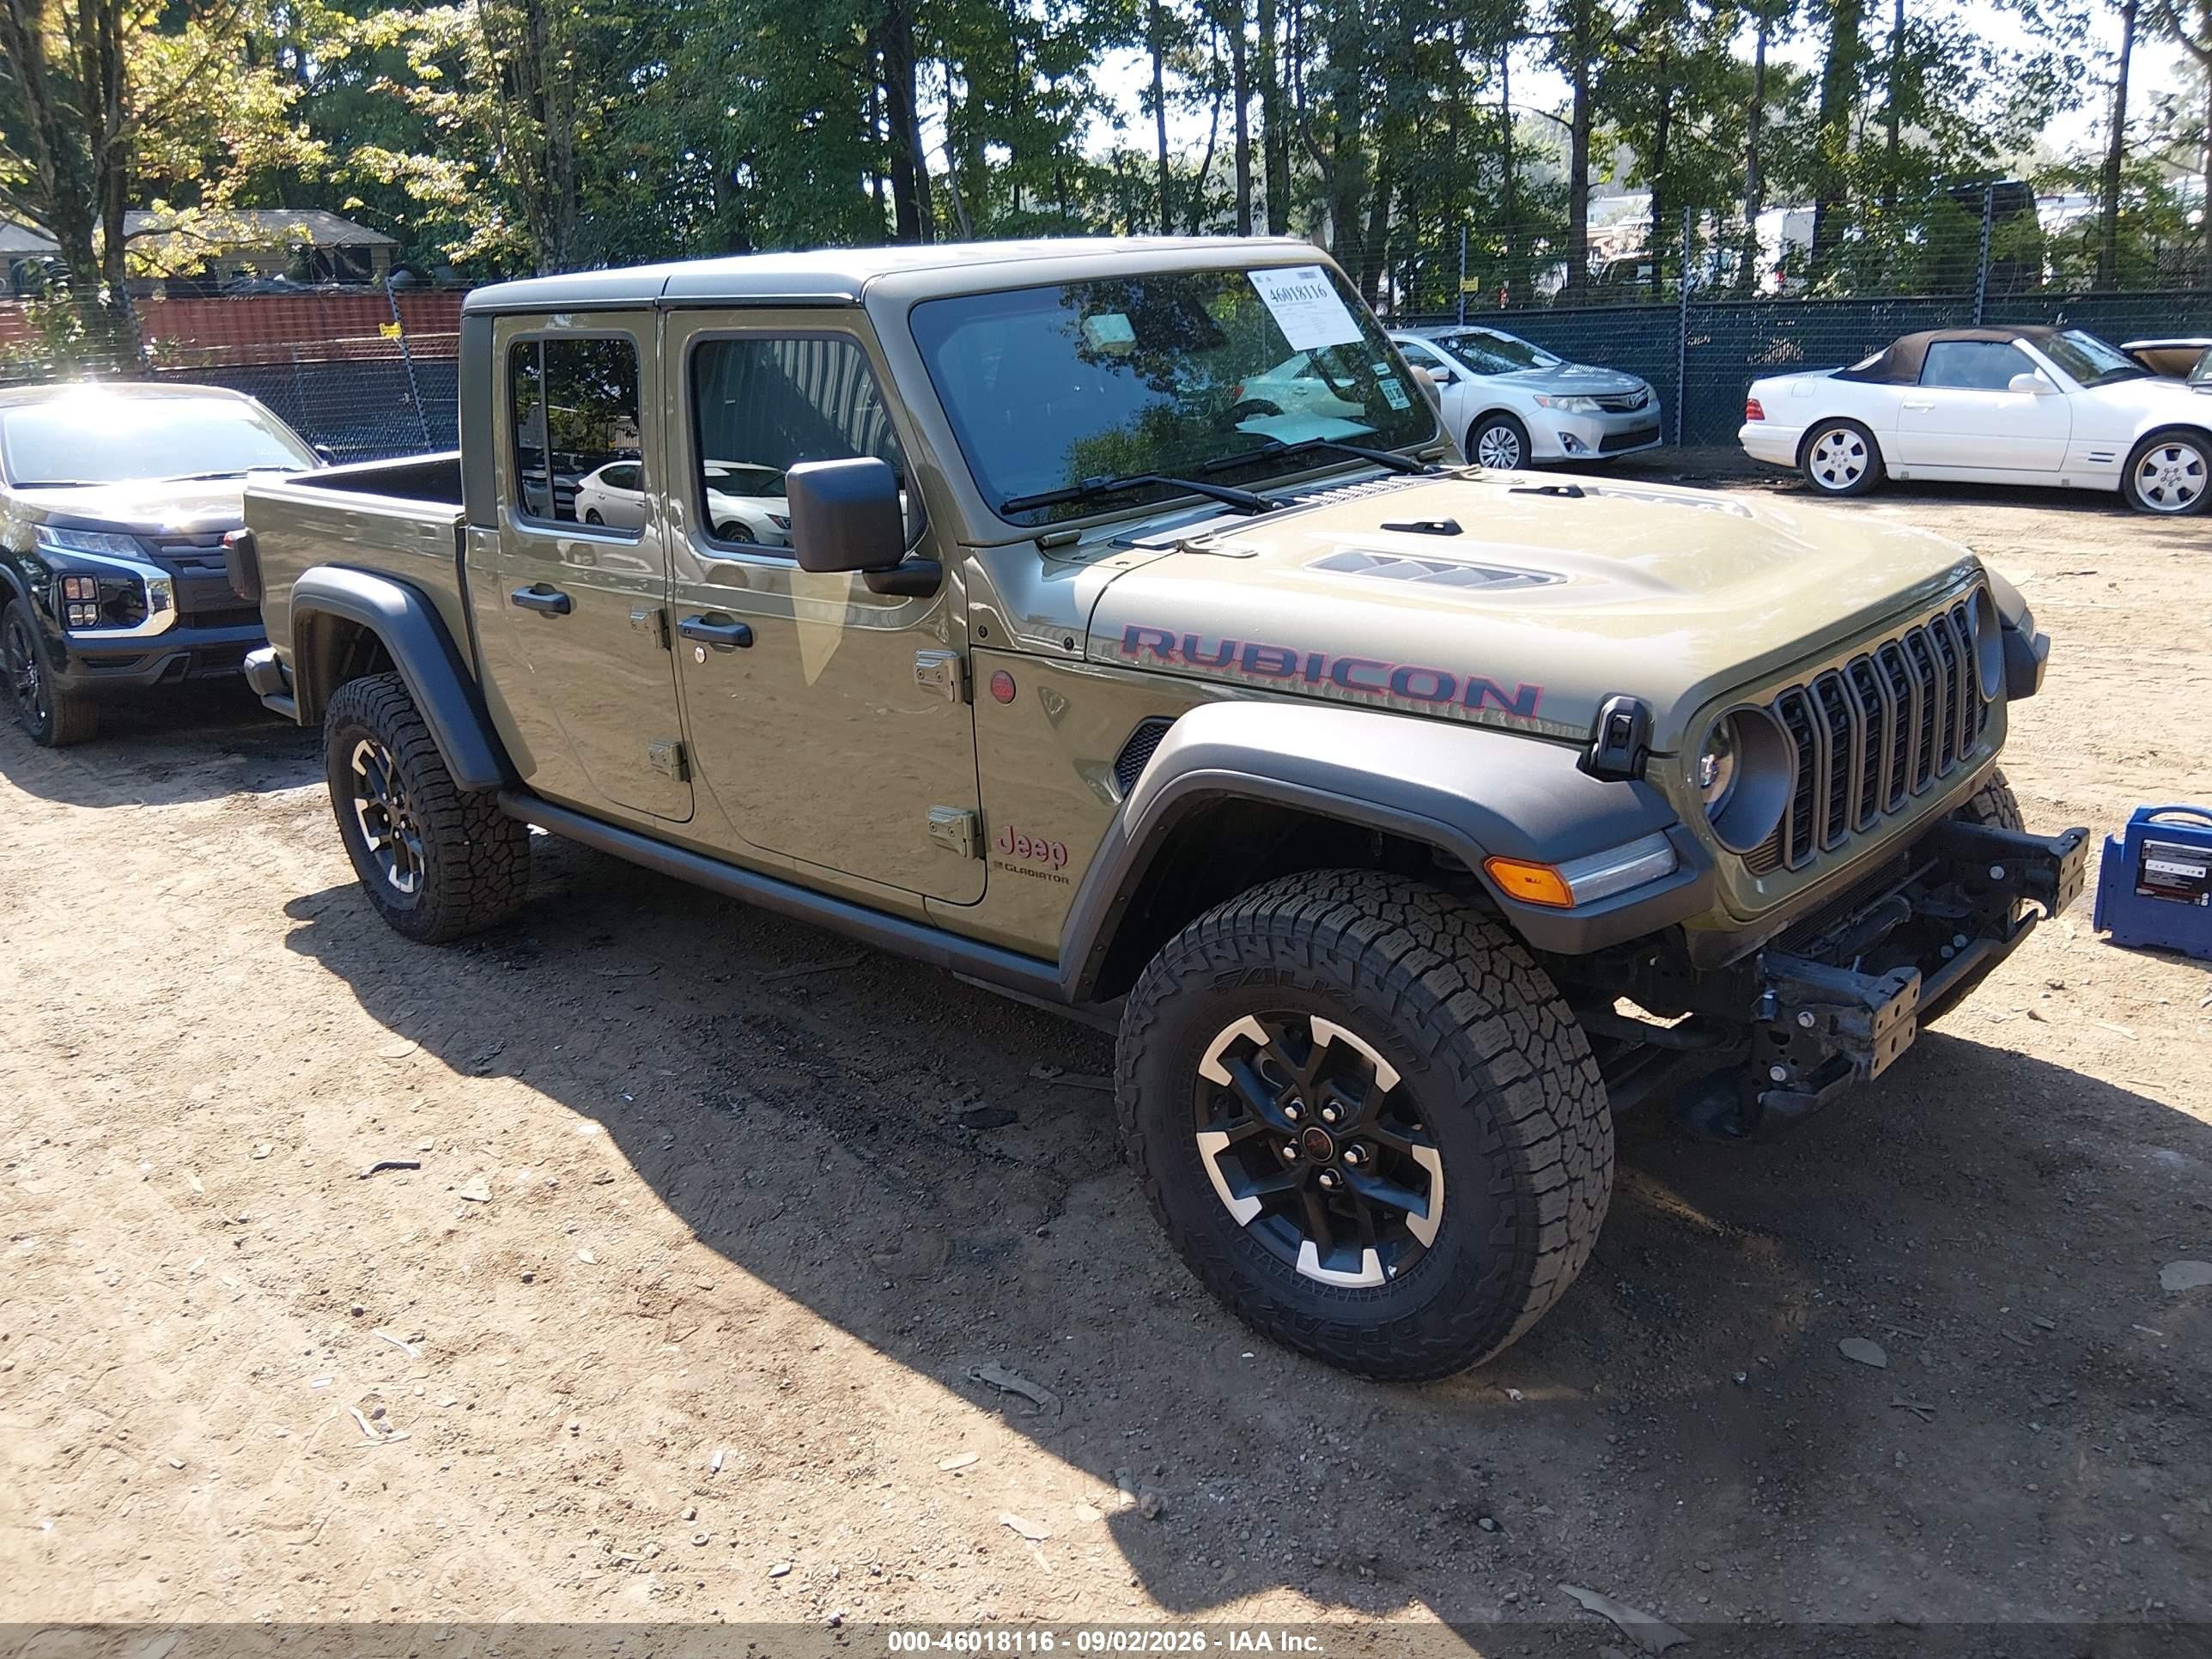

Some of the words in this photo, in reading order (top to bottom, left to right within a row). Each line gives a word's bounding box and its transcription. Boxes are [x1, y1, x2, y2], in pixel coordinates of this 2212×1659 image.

[1270, 283, 1328, 303] 46018116
[1119, 624, 1544, 719] RUBICON
[996, 824, 1068, 871] Jeep
[1005, 863, 1070, 885] GLADIATOR
